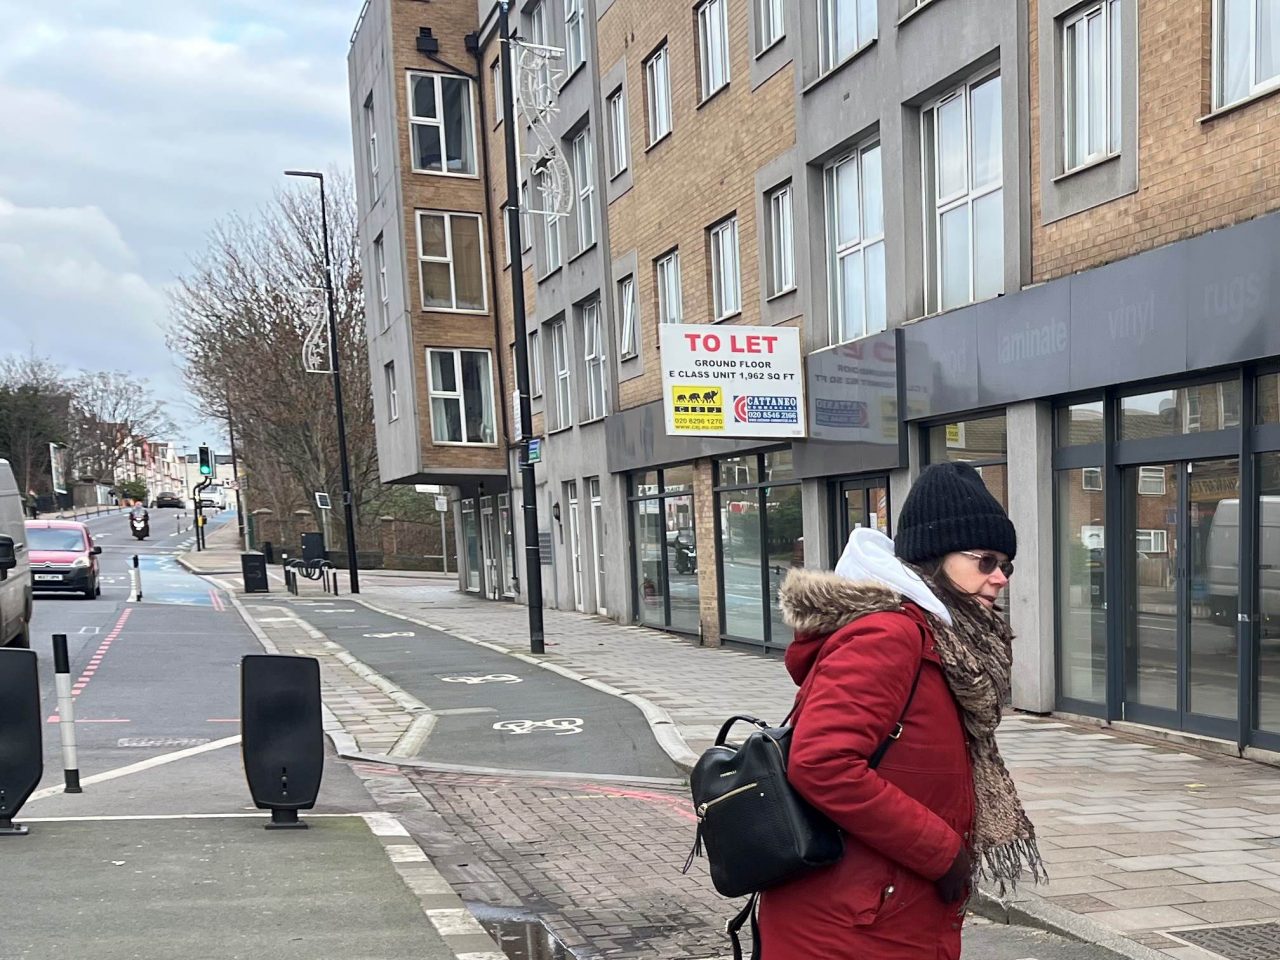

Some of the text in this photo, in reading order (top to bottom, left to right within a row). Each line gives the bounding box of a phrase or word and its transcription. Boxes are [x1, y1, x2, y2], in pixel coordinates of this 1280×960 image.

[1204, 274, 1262, 323] rugs
[1108, 294, 1155, 345] vinyl
[684, 333, 778, 354] TO LET
[997, 317, 1068, 364] laminate
[694, 360, 771, 369] GROUND FLOOR
[678, 371, 710, 379] CLASS
[713, 371, 736, 379] UNIT
[739, 372, 765, 381] 1,962
[747, 396, 797, 407] CATTANEO
[762, 411, 781, 419] 8546
